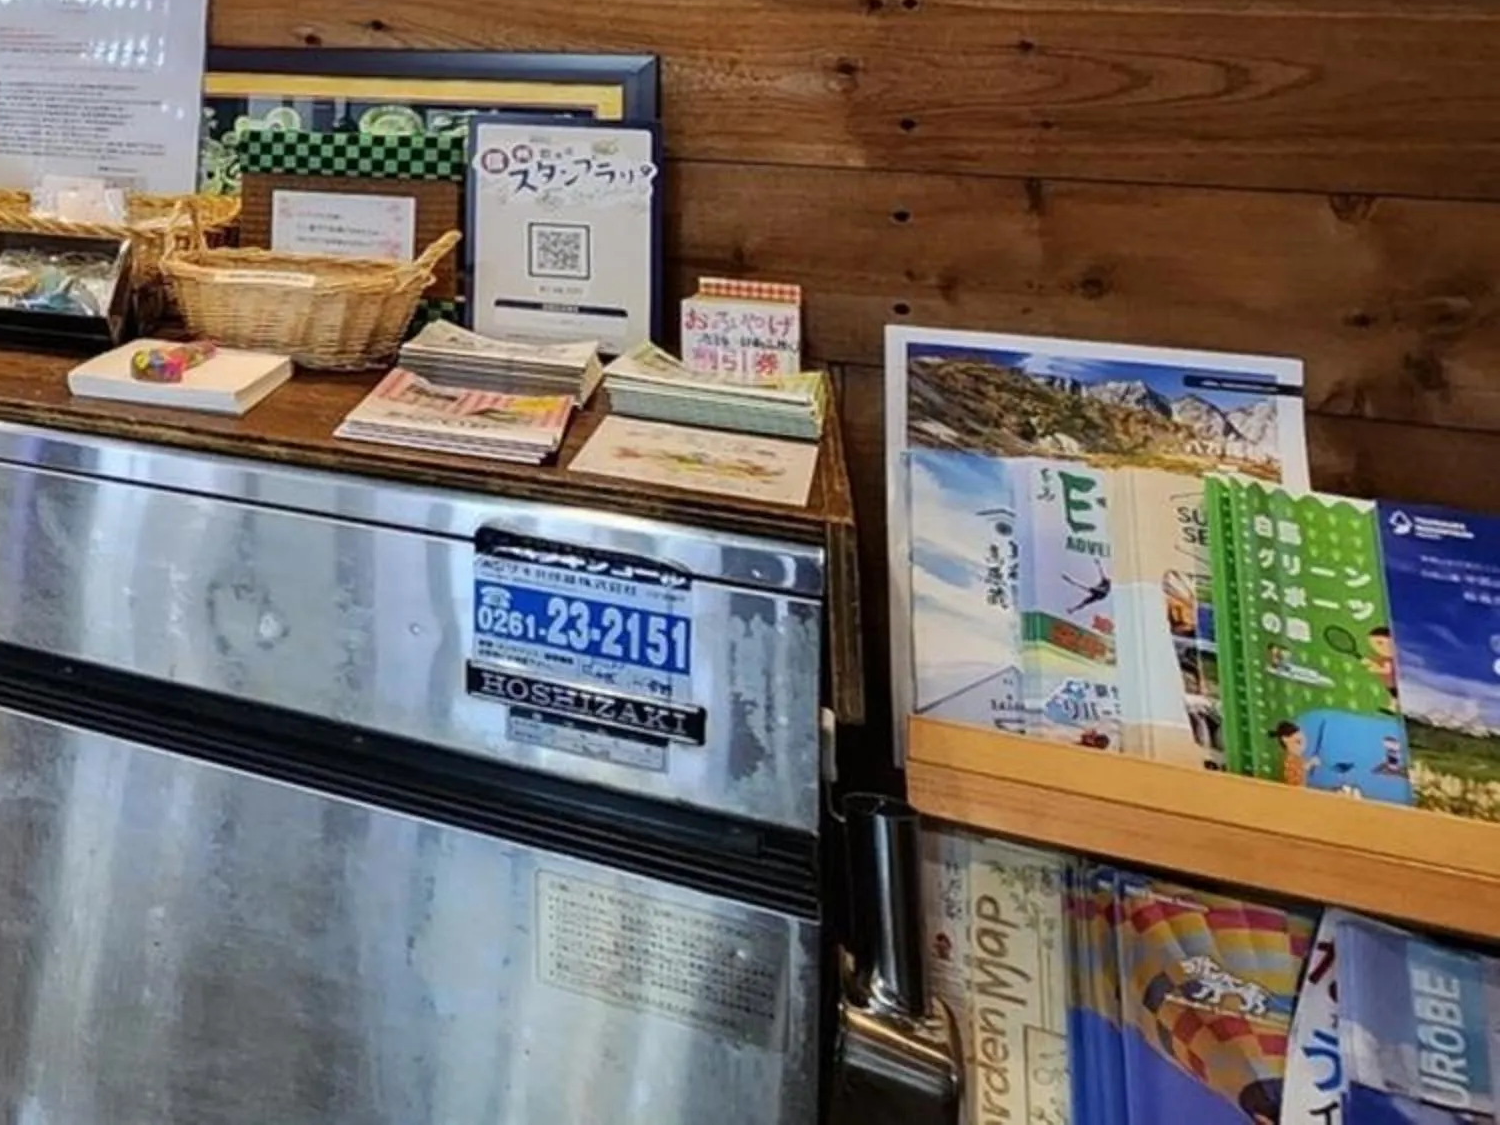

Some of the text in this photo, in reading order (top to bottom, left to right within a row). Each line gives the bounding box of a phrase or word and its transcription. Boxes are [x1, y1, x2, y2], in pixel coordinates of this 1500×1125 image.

[1257, 547, 1372, 588] グリーン
[480, 672, 688, 735] HOSHIZAKI
[974, 893, 1033, 1007] Map
